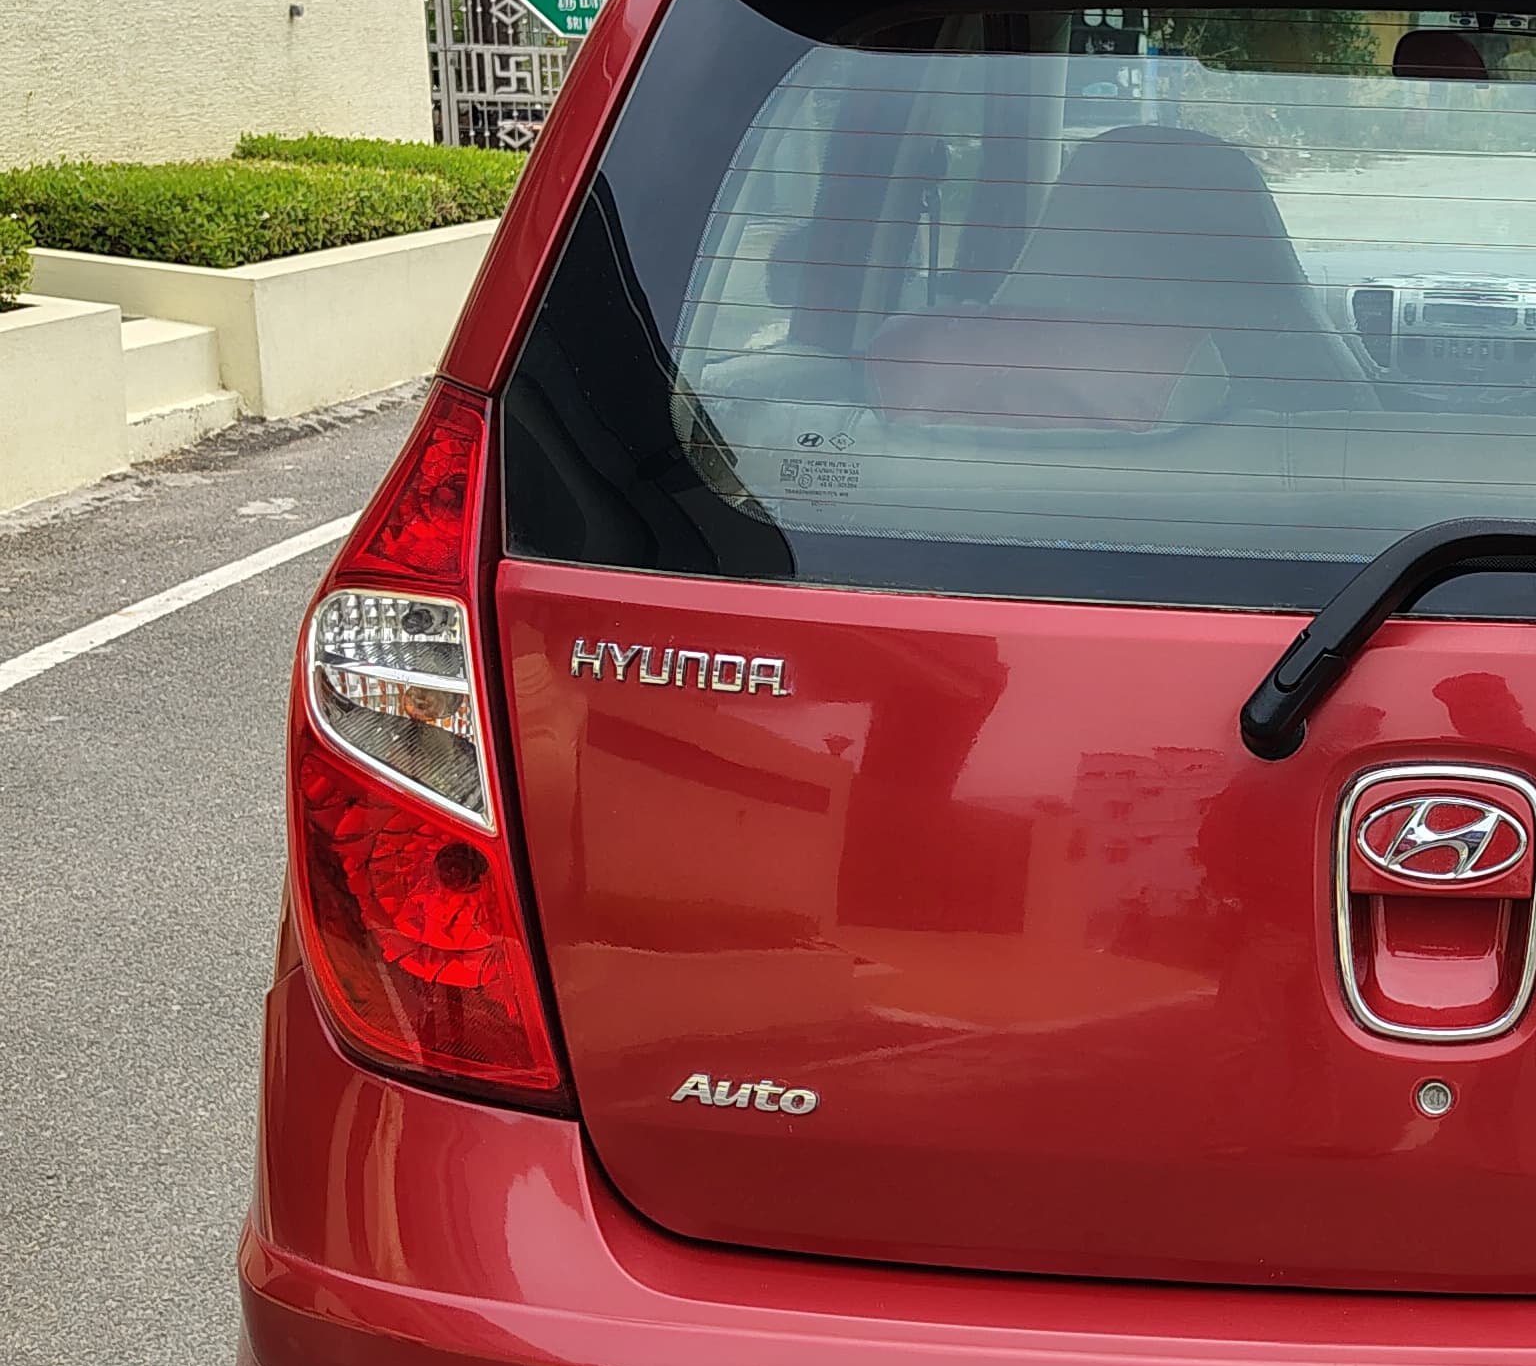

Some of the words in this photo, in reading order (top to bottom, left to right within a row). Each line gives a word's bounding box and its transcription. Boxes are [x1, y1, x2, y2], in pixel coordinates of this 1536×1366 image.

[566, 15, 583, 31] SRI
[570, 639, 789, 696] HYUNDA
[670, 1073, 817, 1115] Auto
